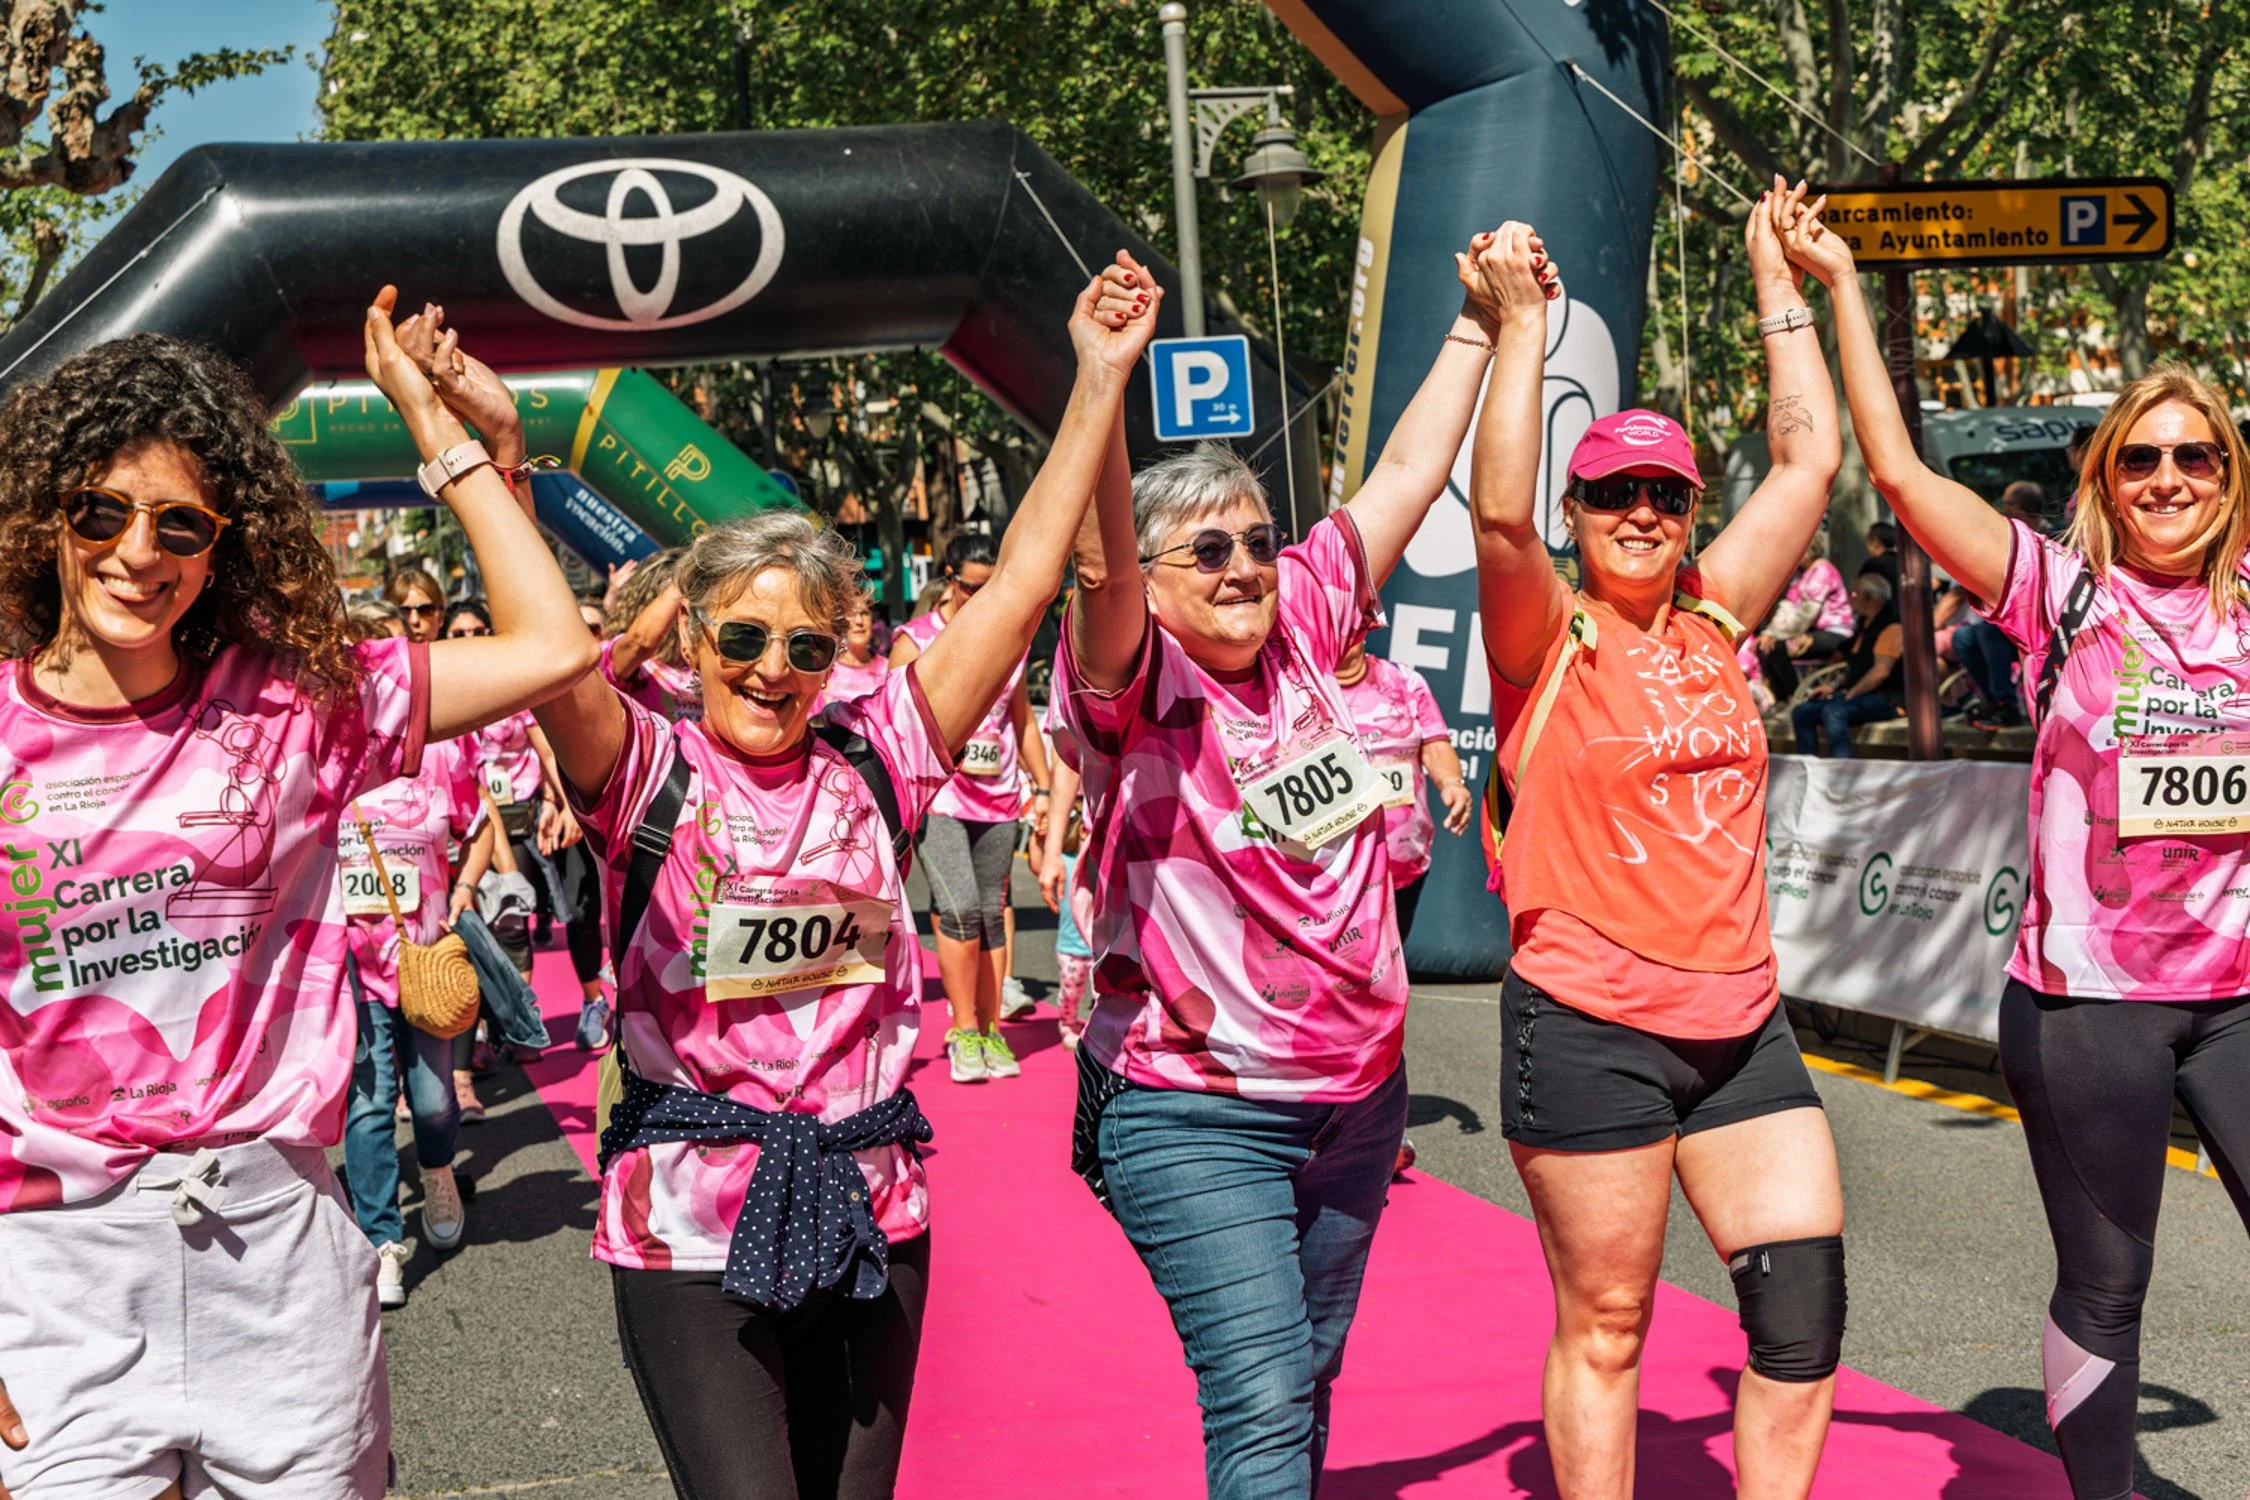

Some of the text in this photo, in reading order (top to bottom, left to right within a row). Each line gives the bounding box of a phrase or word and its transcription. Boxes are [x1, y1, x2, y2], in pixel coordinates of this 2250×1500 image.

[1880, 226, 2049, 253] Ayuntamiento
[2067, 200, 2098, 242] P
[1171, 350, 1230, 428] P
[2145, 697, 2218, 719] por la
[47, 790, 81, 801] contra
[83, 788, 93, 797] el
[49, 799, 106, 812] en La Rioja
[1264, 752, 1354, 826] 7805
[2140, 764, 2247, 807] 7806
[47, 838, 83, 870] XI
[53, 863, 193, 909] Carrera
[5, 843, 65, 993] mujer
[61, 907, 161, 956] por la
[738, 911, 861, 965] 7804
[129, 1081, 177, 1100] La Rioja
